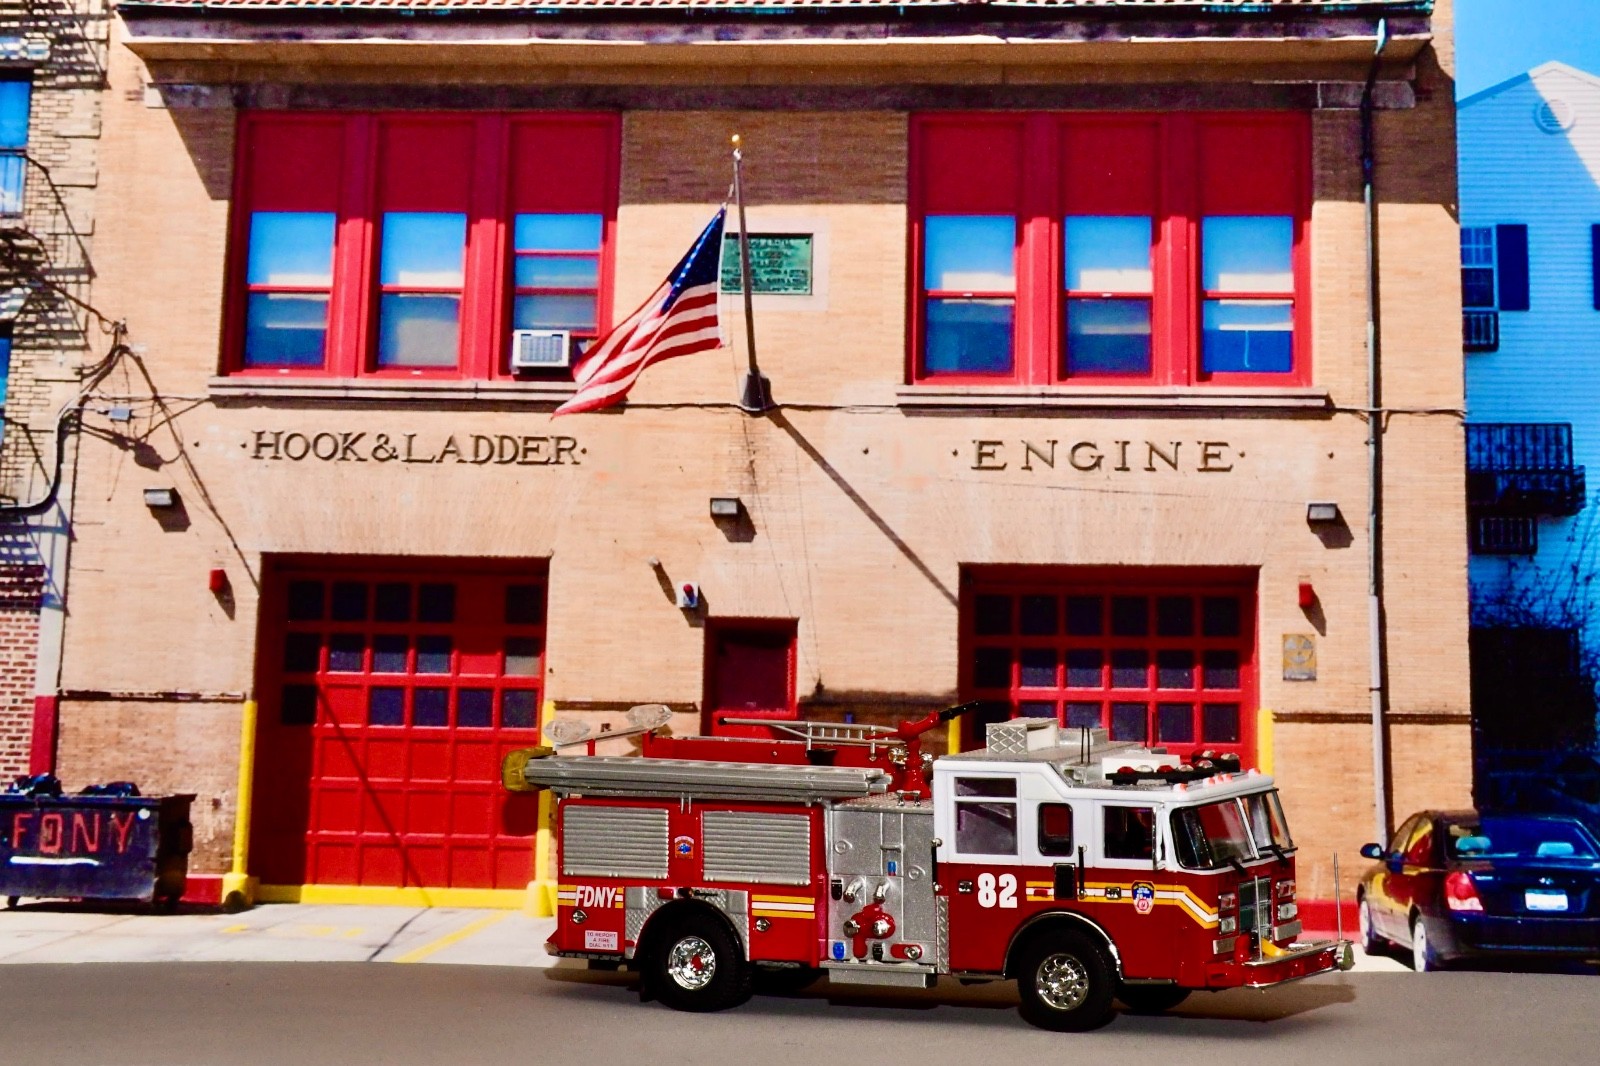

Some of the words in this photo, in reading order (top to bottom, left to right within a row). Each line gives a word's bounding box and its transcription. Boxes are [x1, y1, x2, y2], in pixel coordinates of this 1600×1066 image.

[971, 439, 1233, 472] ENGINE
[12, 811, 135, 853] FDNY
[575, 886, 616, 908] FDNY
[977, 872, 1018, 909] 82
